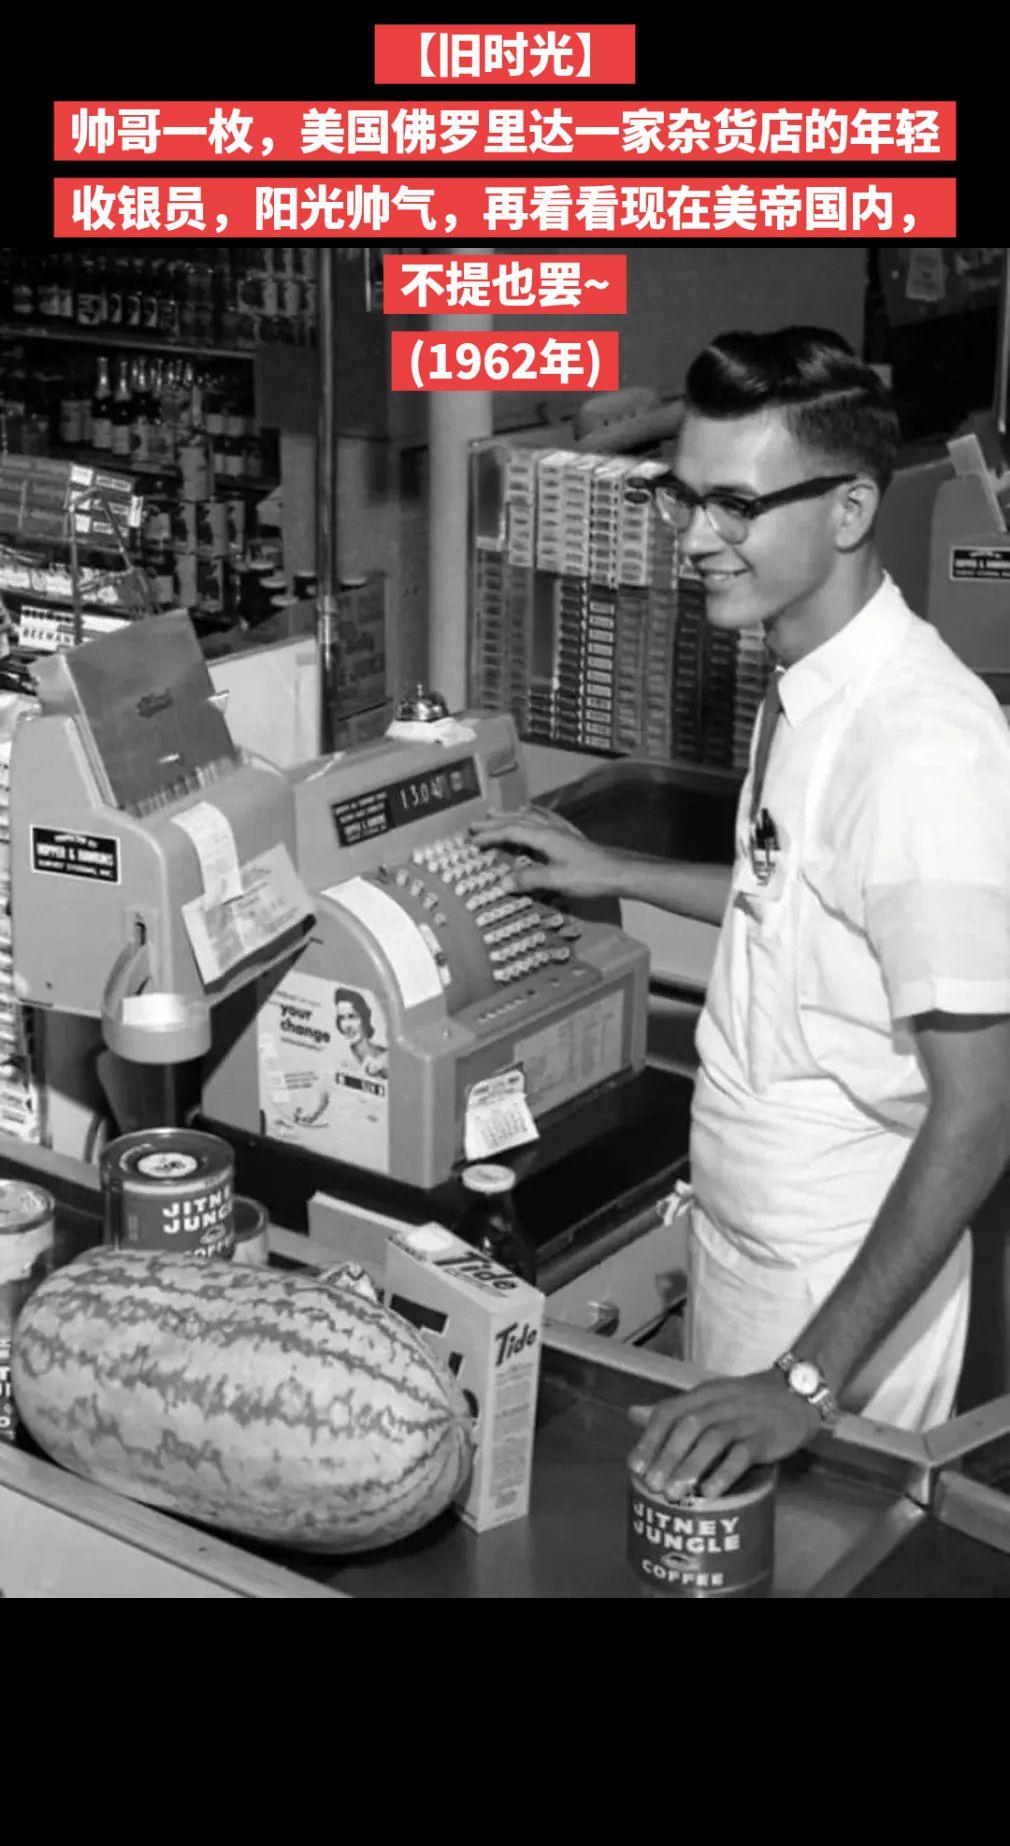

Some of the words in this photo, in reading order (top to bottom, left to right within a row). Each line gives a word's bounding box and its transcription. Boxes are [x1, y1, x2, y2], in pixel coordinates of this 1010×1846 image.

[280, 1004, 313, 1021] your
[280, 1018, 331, 1043] change
[433, 1251, 519, 1290] Tide
[495, 1322, 539, 1368] Tide
[633, 1502, 740, 1536] JITNEY
[633, 1519, 741, 1554] JUNGLE
[641, 1559, 725, 1587] COFFEE
